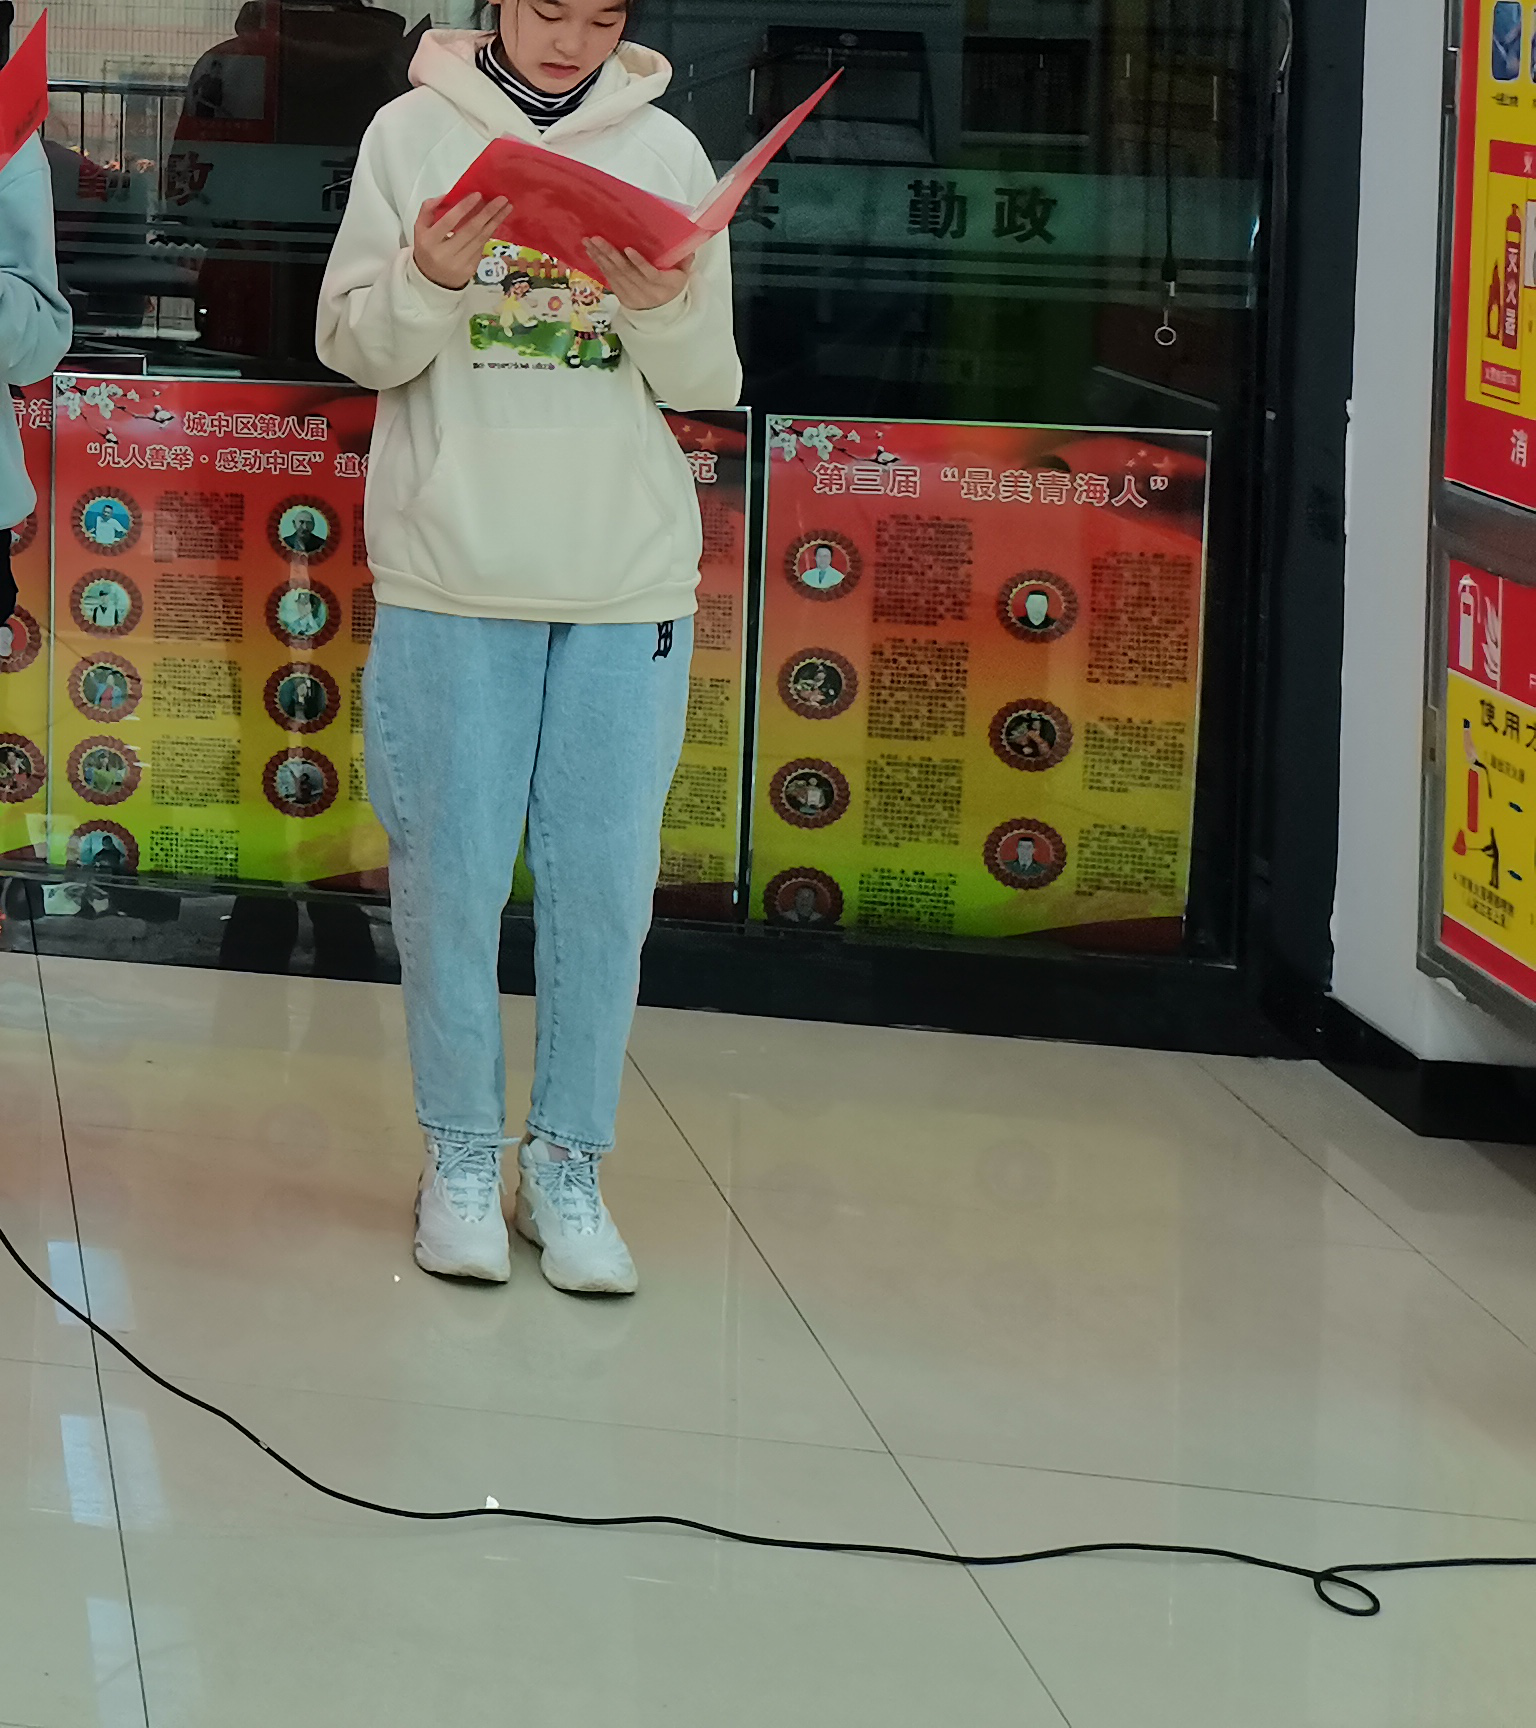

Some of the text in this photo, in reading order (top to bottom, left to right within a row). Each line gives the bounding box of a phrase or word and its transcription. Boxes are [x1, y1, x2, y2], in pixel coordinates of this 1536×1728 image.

[904, 177, 1060, 245] 勤政
[183, 411, 329, 441] 城中区第八届
